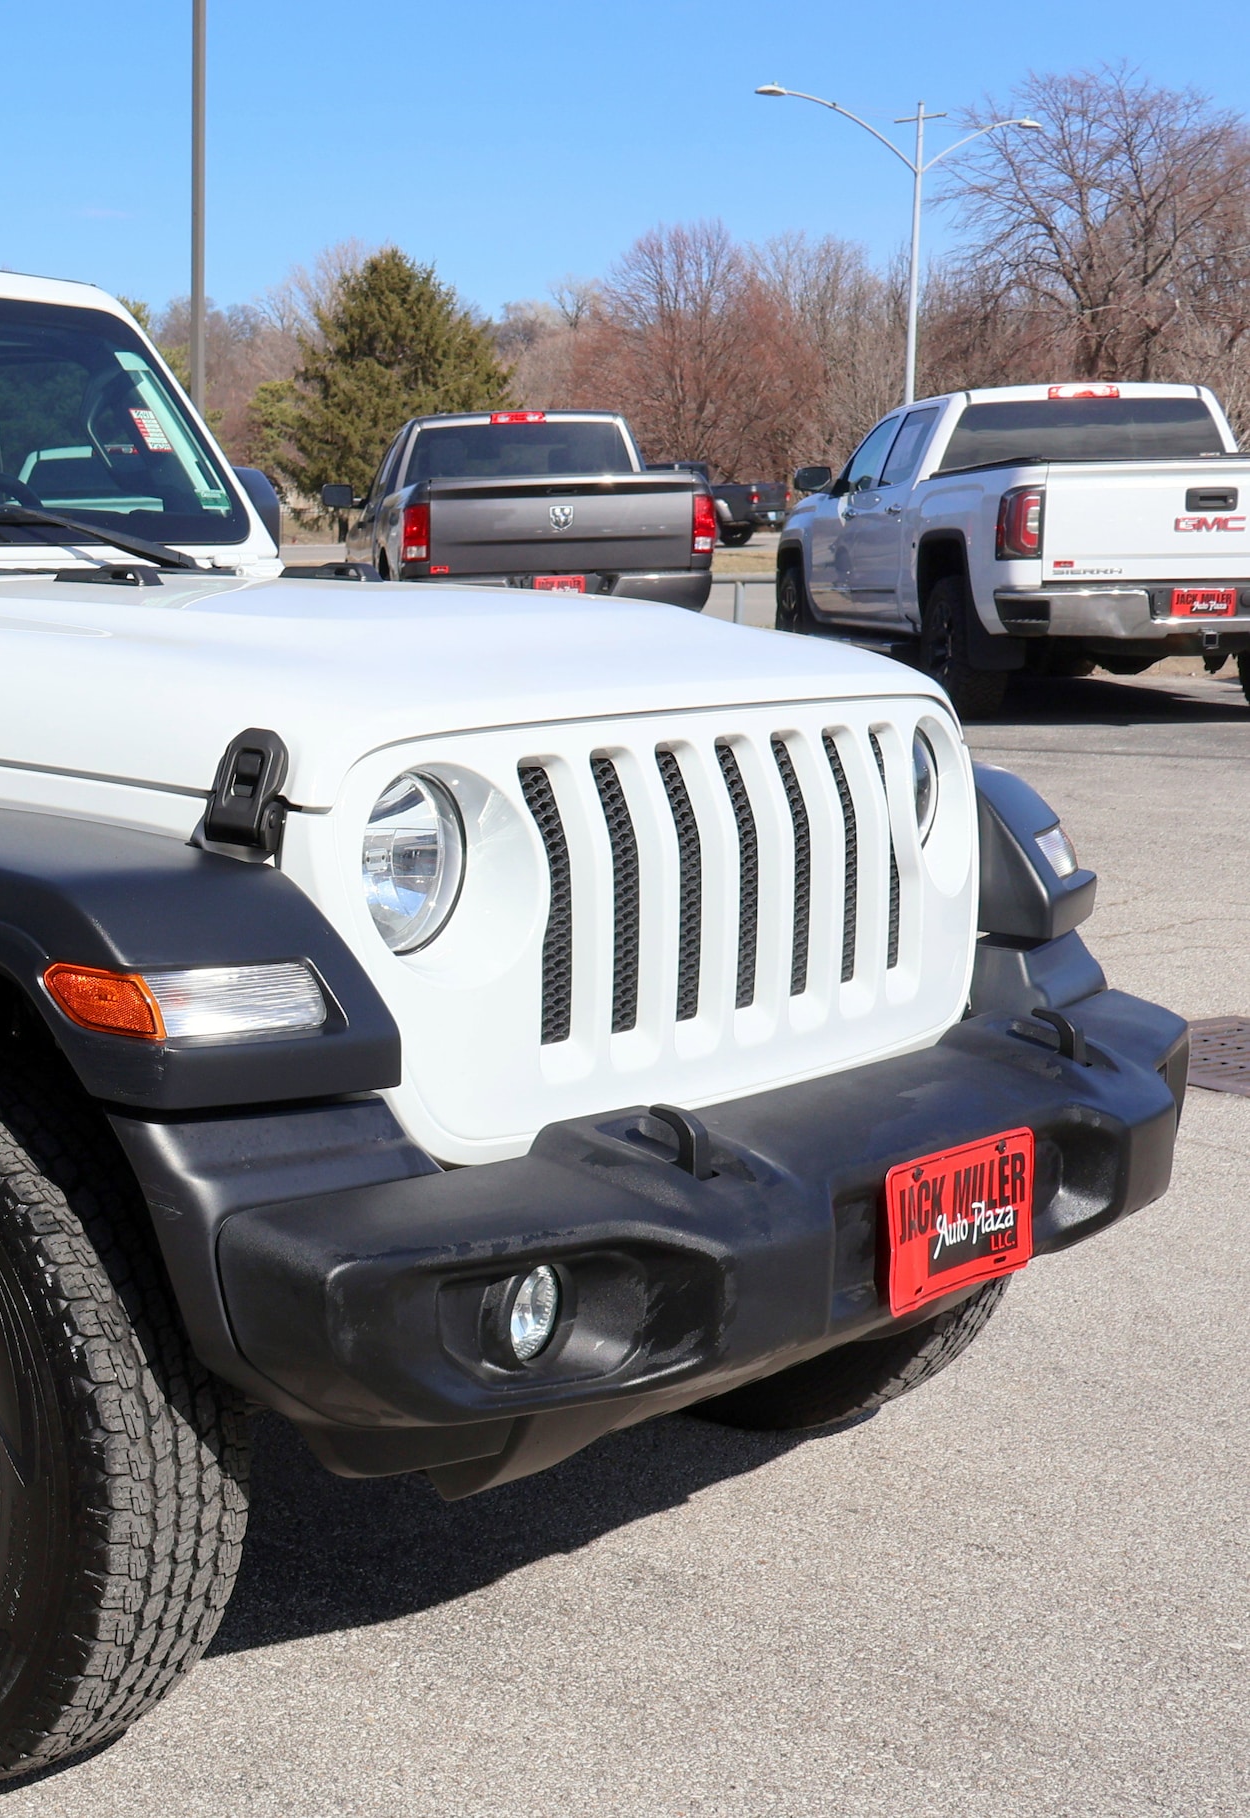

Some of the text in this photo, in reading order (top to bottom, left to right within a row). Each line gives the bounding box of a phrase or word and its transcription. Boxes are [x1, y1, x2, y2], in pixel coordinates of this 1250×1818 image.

[1174, 516, 1247, 532] GMC
[1052, 568, 1123, 576] SIERRA
[1175, 593, 1233, 606] JACK MILLER
[899, 1152, 1026, 1245] JACK MILLER
[933, 1200, 1014, 1260] Auto Plaza
[989, 1230, 1016, 1251] LLC.
